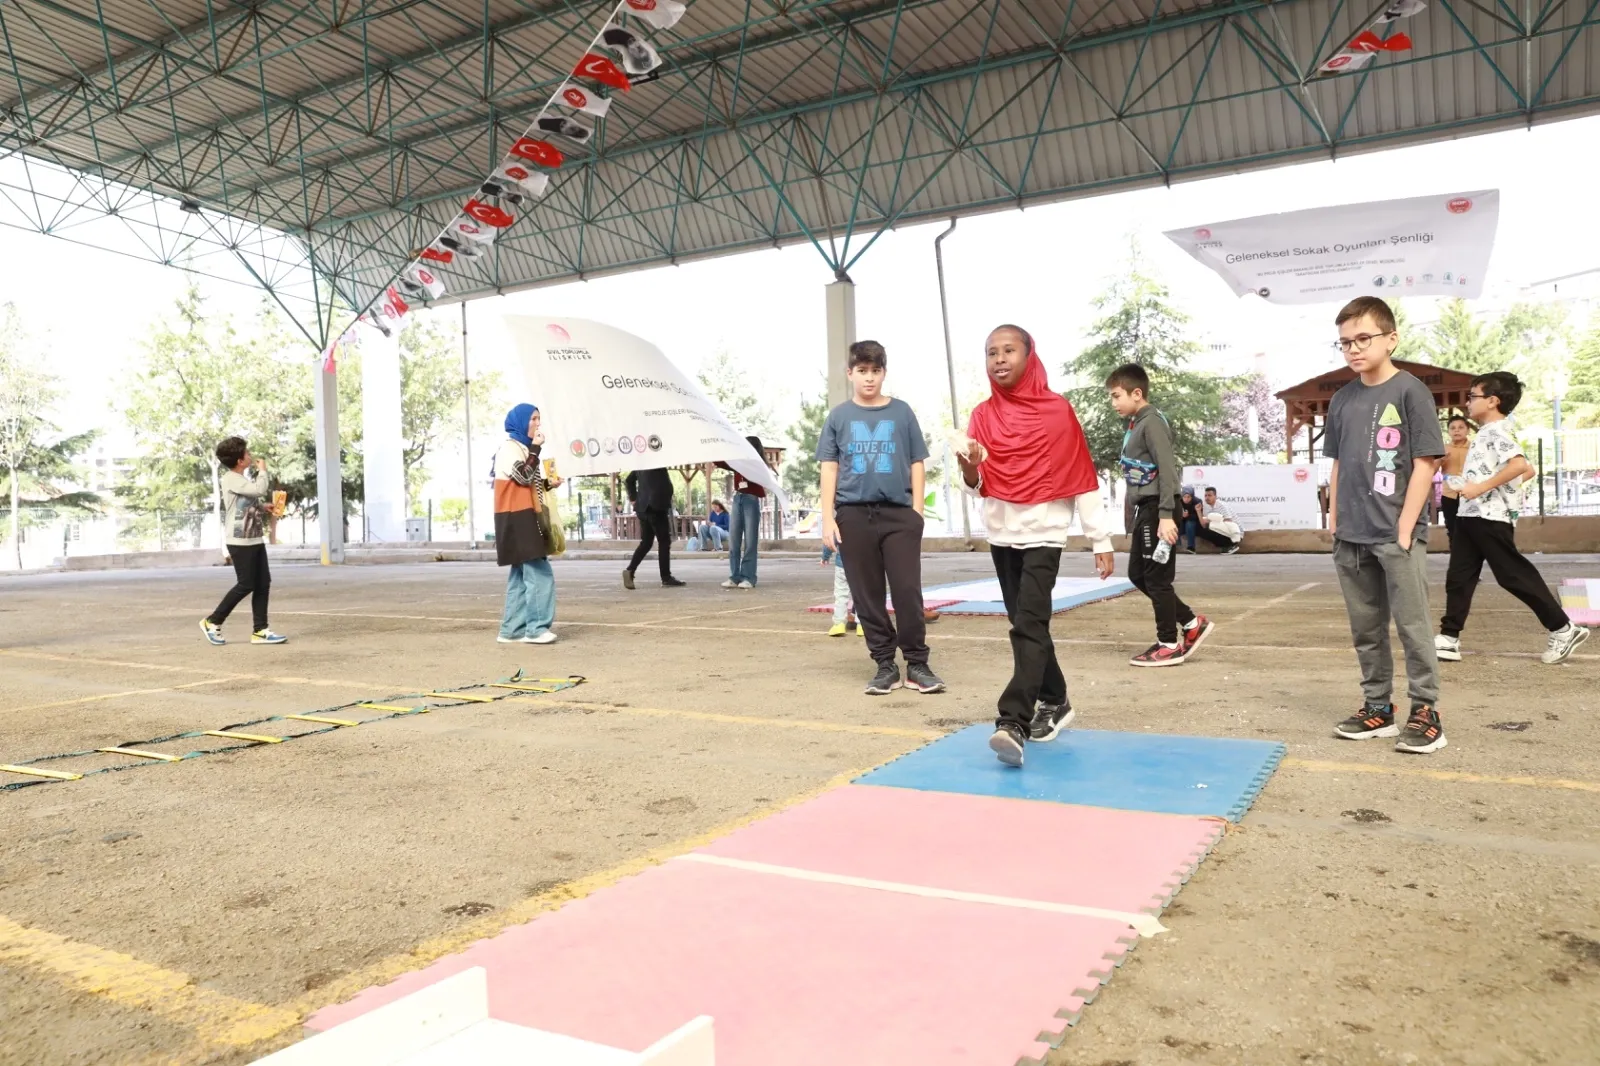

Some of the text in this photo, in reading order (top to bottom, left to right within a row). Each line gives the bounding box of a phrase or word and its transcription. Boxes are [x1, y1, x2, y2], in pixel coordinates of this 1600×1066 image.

[1226, 232, 1434, 264] Geleneksel Sokak Oyunları Şenliği
[602, 374, 671, 392] Geleneksel
[848, 441, 896, 454] MOVE ON
